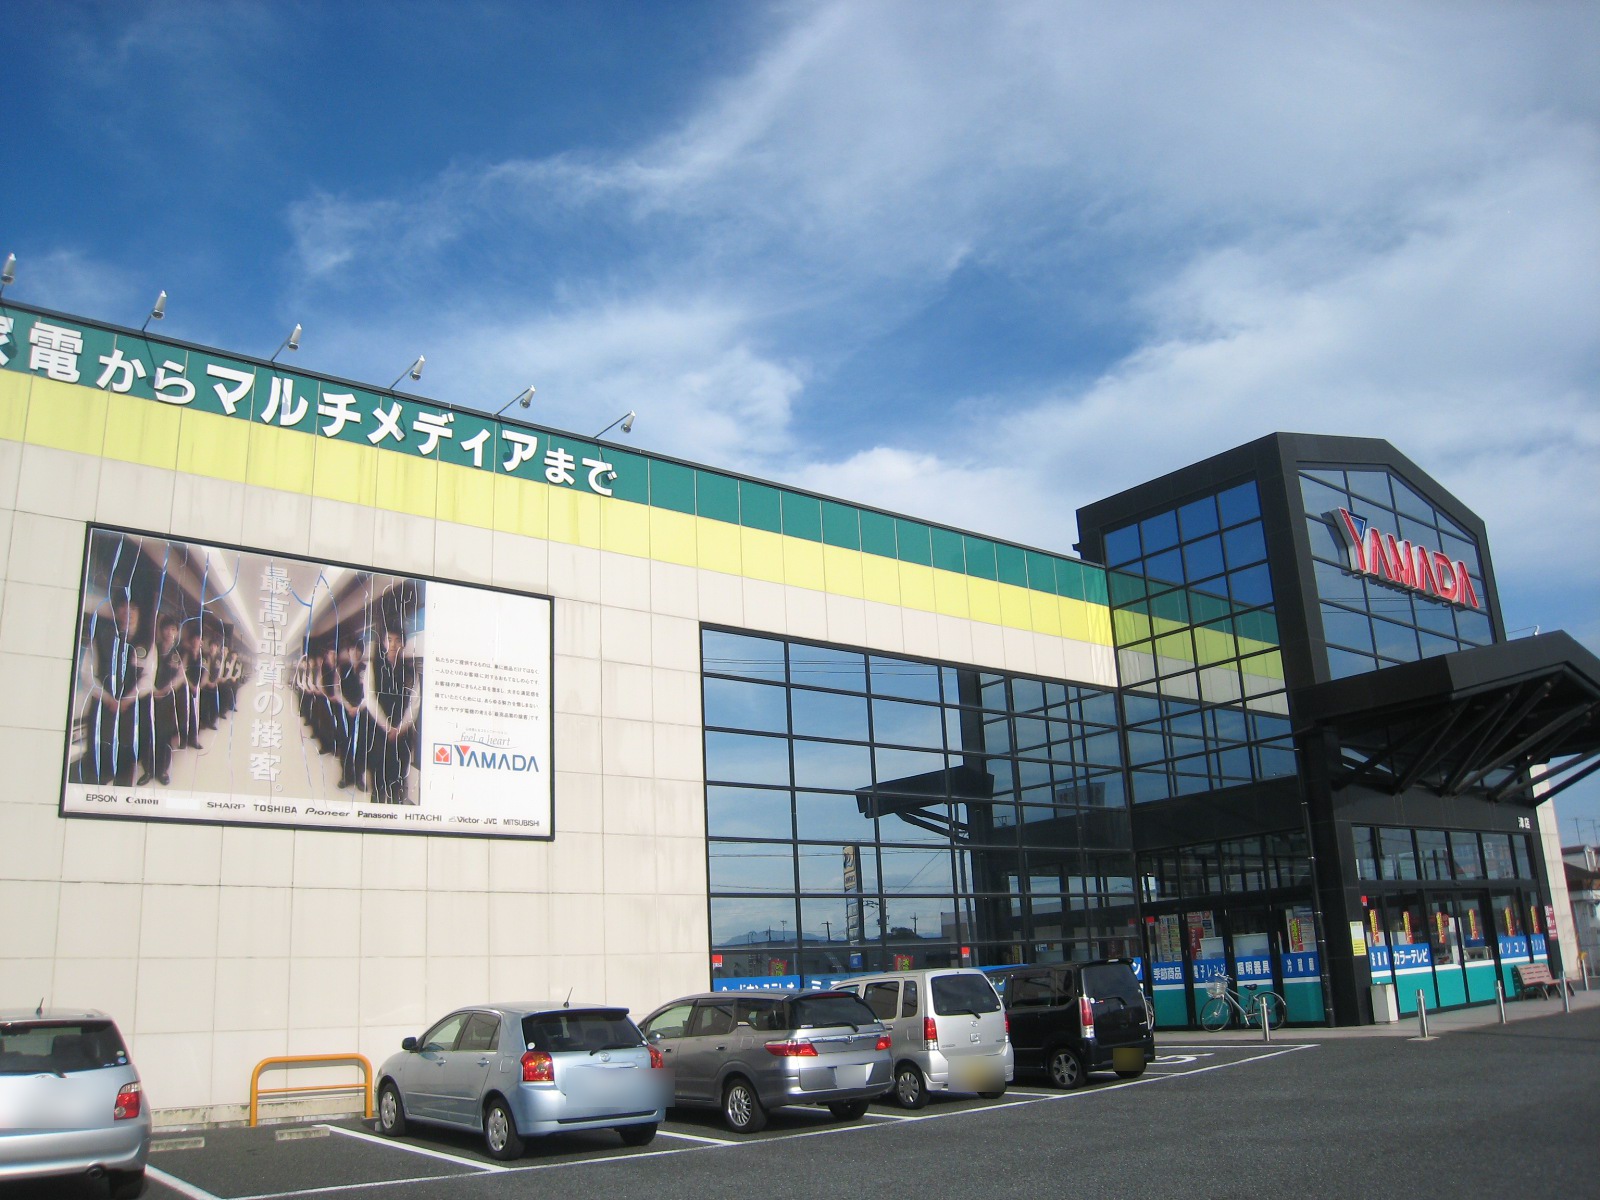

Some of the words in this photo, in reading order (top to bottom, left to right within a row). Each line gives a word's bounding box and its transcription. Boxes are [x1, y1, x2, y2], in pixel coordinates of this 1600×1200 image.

[0, 315, 617, 497] 電からマルチメディアまで
[1336, 506, 1480, 609] YAMADA
[250, 565, 292, 792] 最高品質の接客。
[460, 731, 477, 742] feel
[478, 735, 485, 743] a
[487, 734, 511, 747] heart
[453, 744, 540, 773] YAMADA
[85, 793, 118, 803] EPSON
[125, 796, 159, 806] Canon
[206, 801, 246, 810] SHARP
[253, 804, 298, 815] TOSHIBA
[304, 807, 351, 817] Pioneer
[357, 810, 399, 820] Panasonic
[404, 813, 443, 823] HITACHI
[456, 816, 480, 824] Victor
[483, 817, 498, 825] JVC
[502, 818, 540, 827] MITSUBISHI
[1393, 948, 1429, 965] カラーテレビ
[1153, 966, 1183, 981] 季節商品
